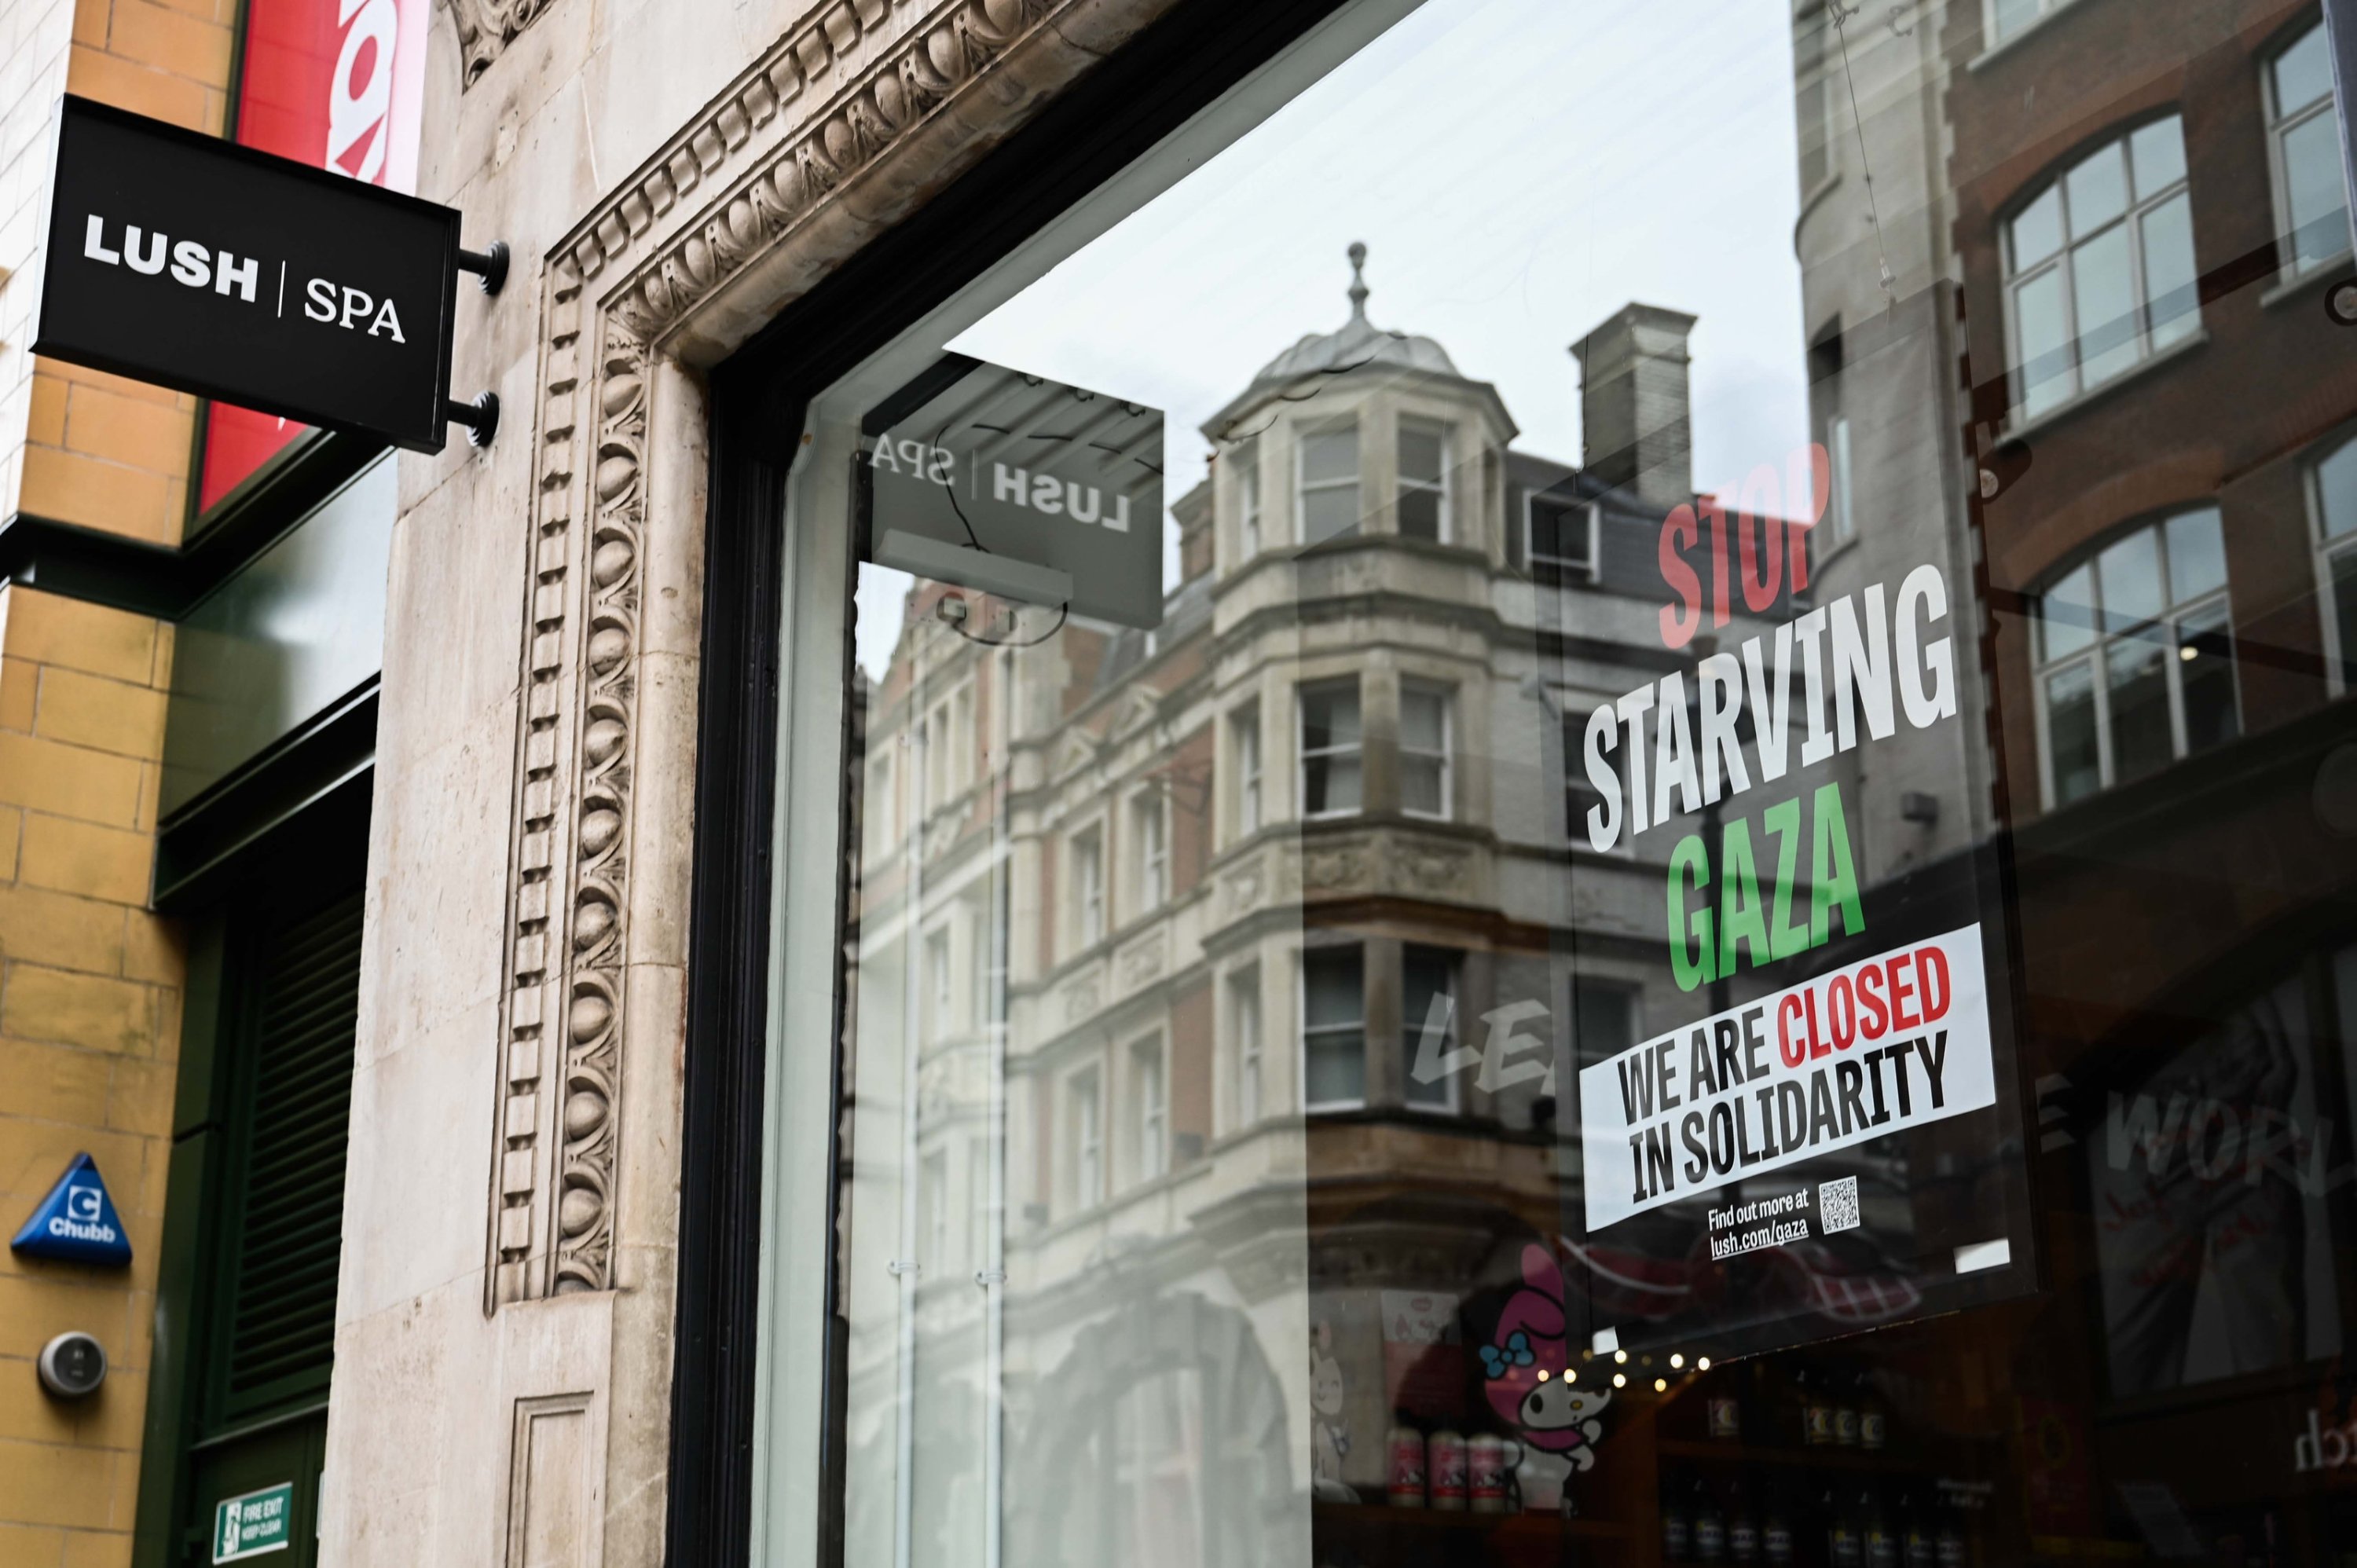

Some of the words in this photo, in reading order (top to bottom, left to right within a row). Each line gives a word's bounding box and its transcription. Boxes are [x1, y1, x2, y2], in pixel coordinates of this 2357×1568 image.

[84, 214, 258, 302] LUSH
[304, 278, 406, 343] SPA
[1659, 442, 1829, 649] STOP
[1584, 564, 1956, 853] STARVING
[1667, 782, 1865, 992] GAZA
[1410, 991, 1555, 1096] LE
[1618, 1039, 1681, 1127] WE
[1690, 1006, 1770, 1101] ARE
[1777, 946, 1951, 1068] CLOSED
[1629, 1121, 1674, 1203] IN
[1681, 1029, 1948, 1183] SOLIDARITY
[49, 1217, 115, 1244] Chubb
[1708, 1204, 1735, 1231] Find
[1736, 1203, 1758, 1223] out
[1759, 1195, 1794, 1218] more
[1795, 1188, 1809, 1211] at
[1710, 1219, 1809, 1260] lush.com/gaza
[243, 1501, 262, 1524] FIRE
[263, 1497, 284, 1519] EXIT
